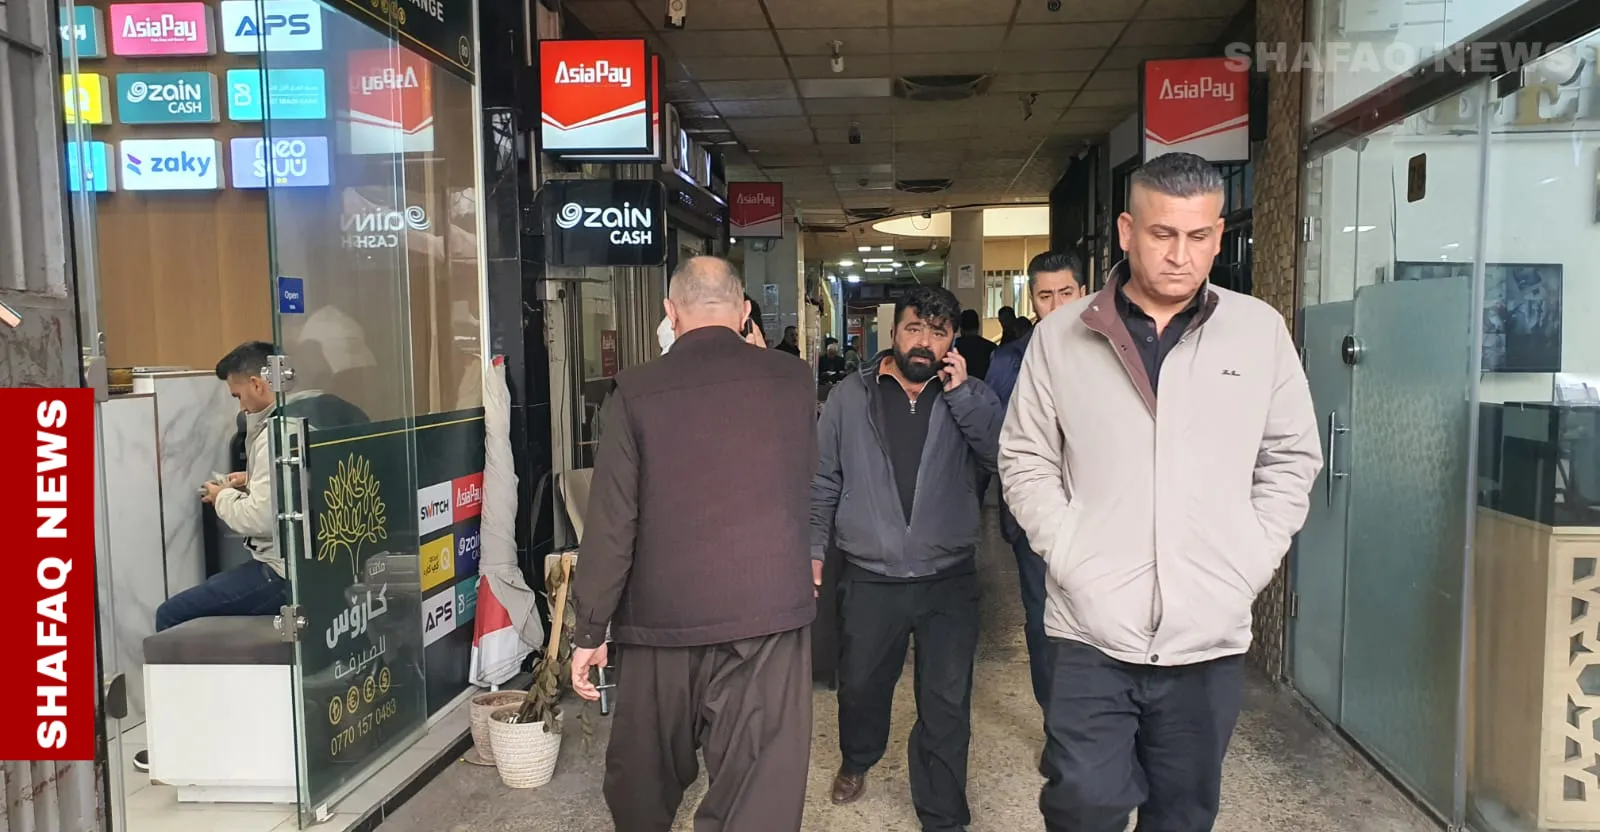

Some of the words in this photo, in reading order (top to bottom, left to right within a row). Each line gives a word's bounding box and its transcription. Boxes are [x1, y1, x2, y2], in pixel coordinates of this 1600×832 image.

[408, 0, 444, 22] ANGE
[122, 14, 197, 41] AsiaPay
[235, 14, 311, 36] APS
[554, 60, 632, 87] AsiaPay
[149, 80, 201, 101] zain
[1159, 77, 1234, 101] AsiaPay
[168, 102, 202, 114] CASH
[151, 151, 211, 177] zaky
[584, 202, 652, 229] zain
[610, 230, 652, 245] CASH
[420, 499, 449, 520] SWITCH
[425, 601, 452, 633] APS
[331, 726, 355, 756] 0770
[357, 713, 373, 737] 157
